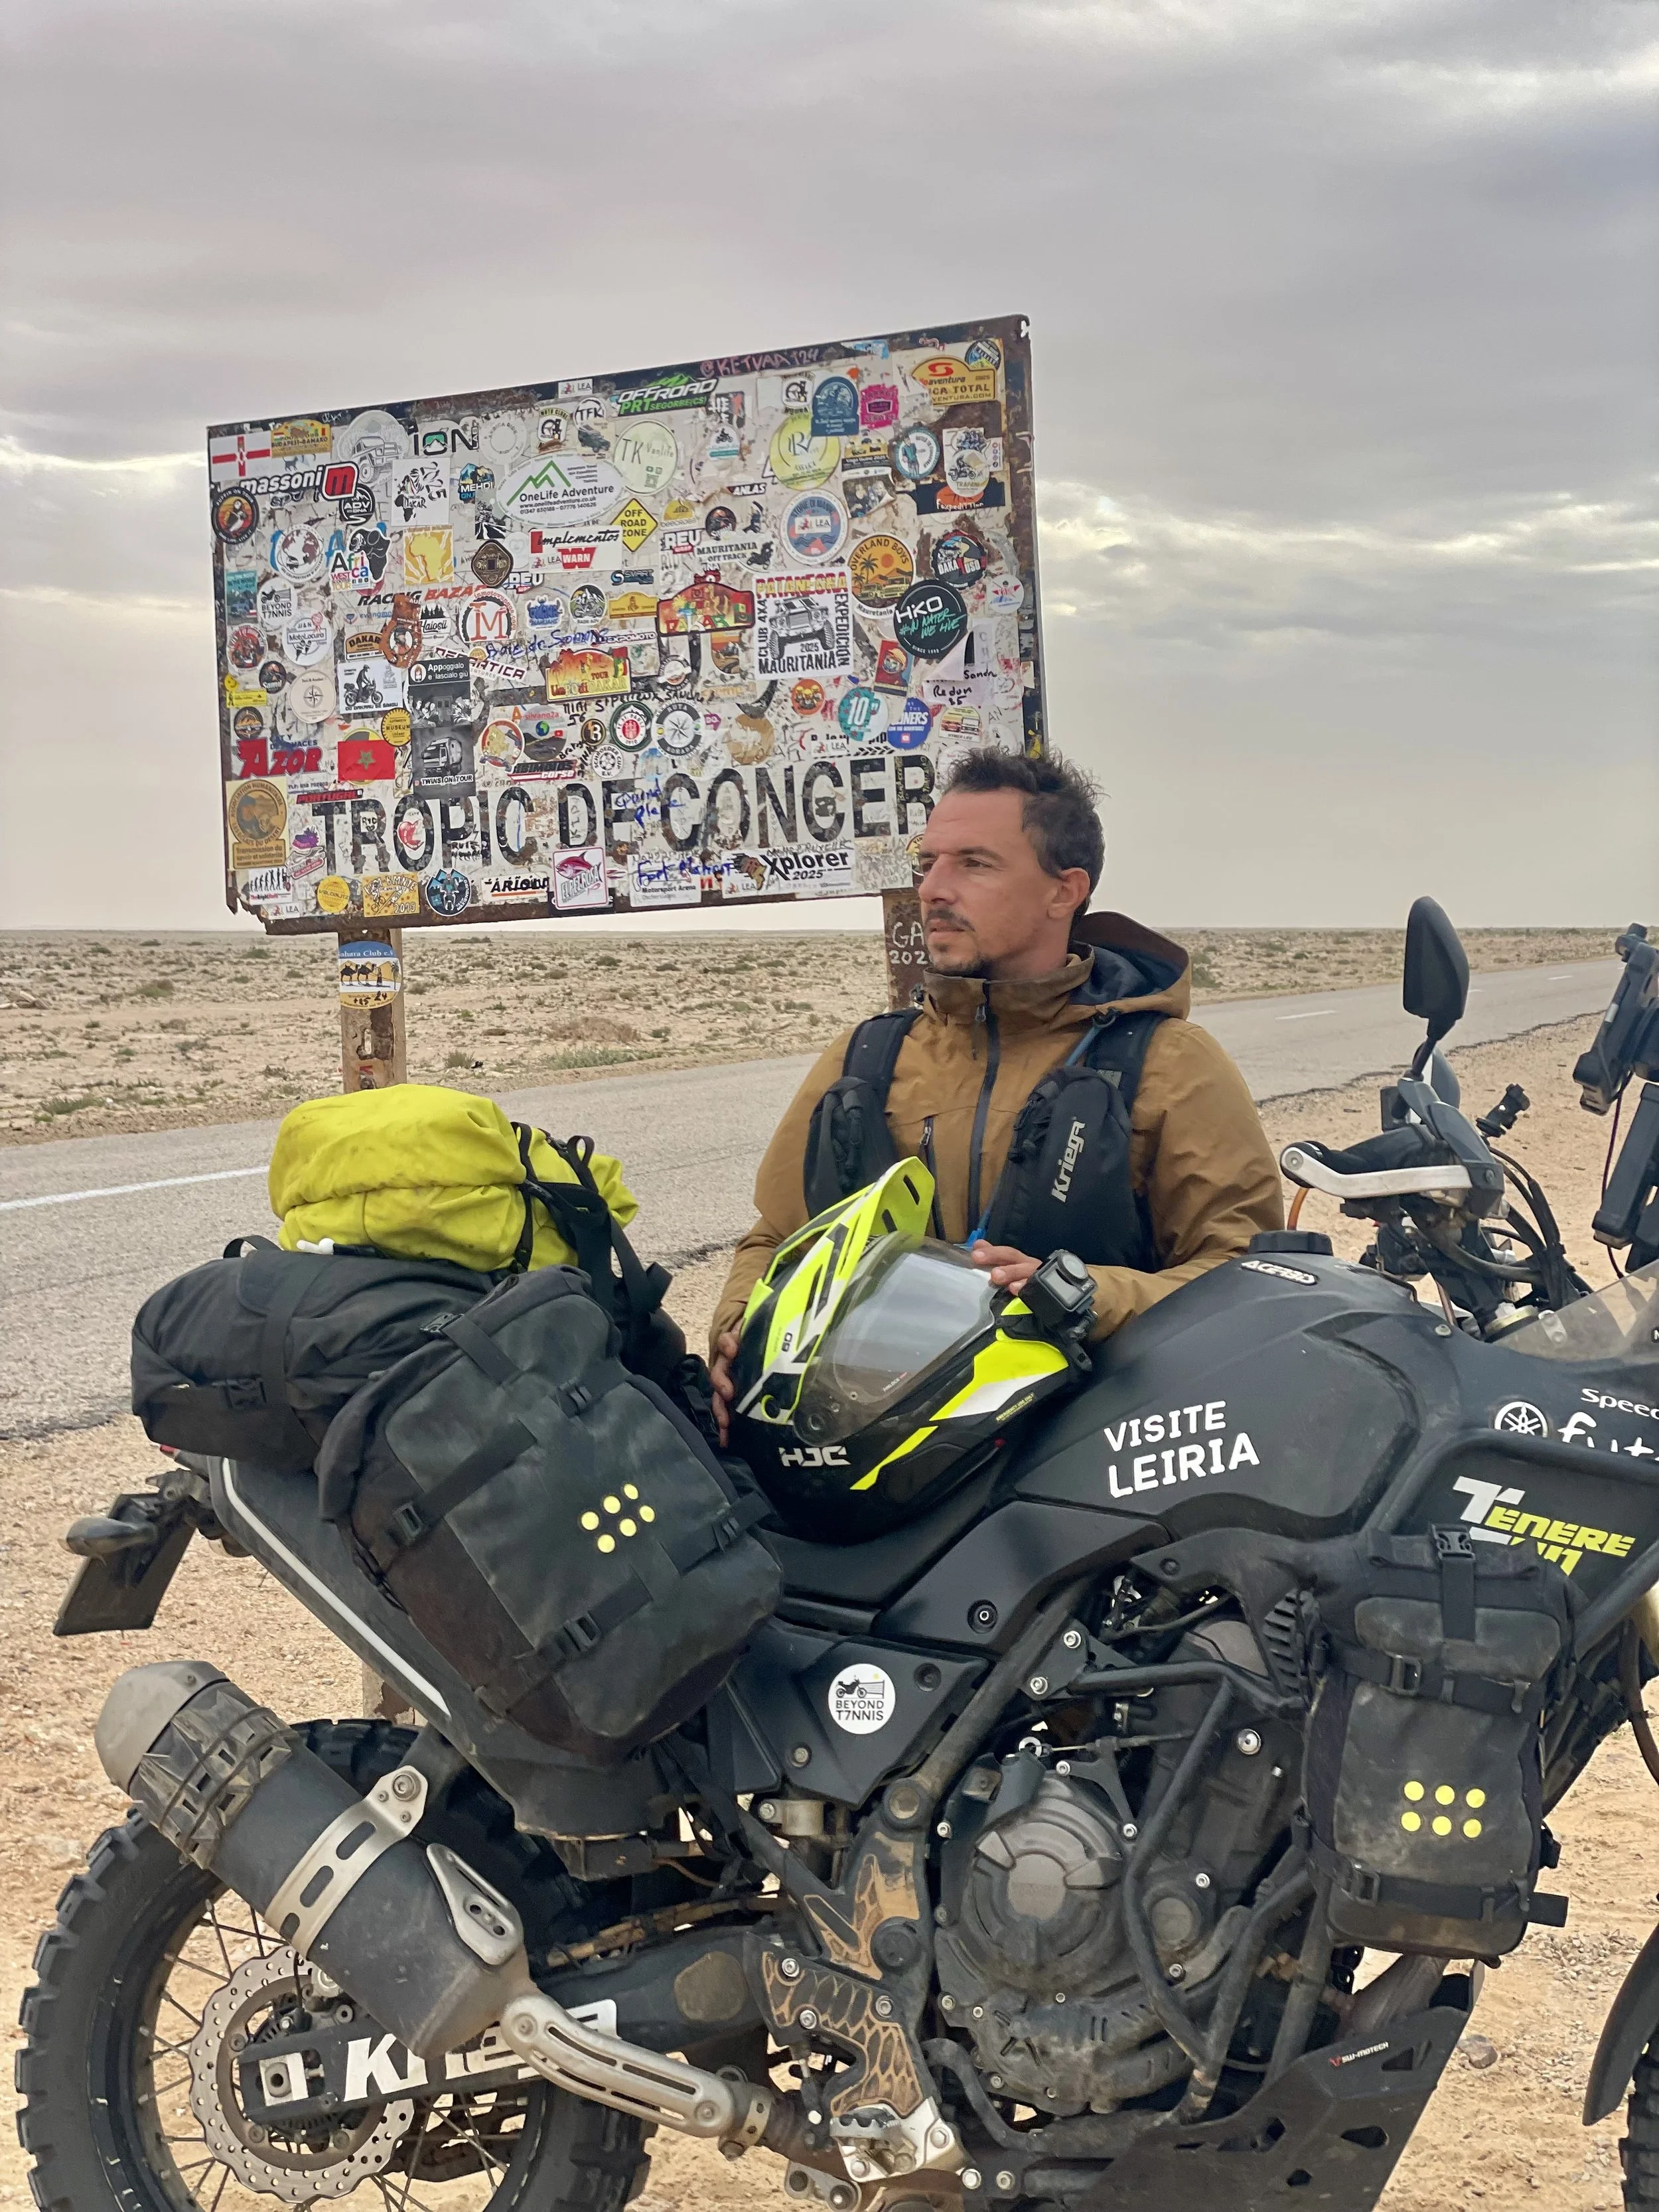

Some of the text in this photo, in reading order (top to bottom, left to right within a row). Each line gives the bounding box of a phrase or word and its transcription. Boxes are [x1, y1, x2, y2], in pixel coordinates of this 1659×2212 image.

[618, 378, 717, 403] OFFROAD
[952, 384, 991, 394] TOTAL
[240, 465, 323, 495] massoni
[460, 481, 494, 492] MEHDI
[520, 484, 614, 502] OneLife Adventure
[344, 501, 370, 510] ADV
[624, 509, 643, 518] OFF
[620, 518, 646, 527] ROAD
[622, 528, 648, 538] ZONE
[697, 542, 758, 555] MAURITANIA
[563, 553, 591, 563] WARN
[261, 601, 292, 611] BEYOND
[261, 609, 293, 619] T7NNIS
[800, 642, 820, 653] 2025
[427, 662, 465, 672] Appoggialo
[758, 650, 837, 674] MAURITANIA
[435, 670, 458, 680] lascialo
[237, 737, 323, 779] AZOR
[312, 786, 535, 875] TROPIC
[760, 851, 849, 881] Xplorer
[792, 869, 824, 881] 2025
[363, 948, 381, 957] Club
[889, 949, 928, 966] 202
[1104, 1400, 1226, 1453] VISITE
[778, 1445, 851, 1467] HJC
[1108, 1432, 1261, 1499] LEIRIA
[835, 1700, 884, 1710] BEYOND
[835, 1710, 884, 1721] T7NNIS
